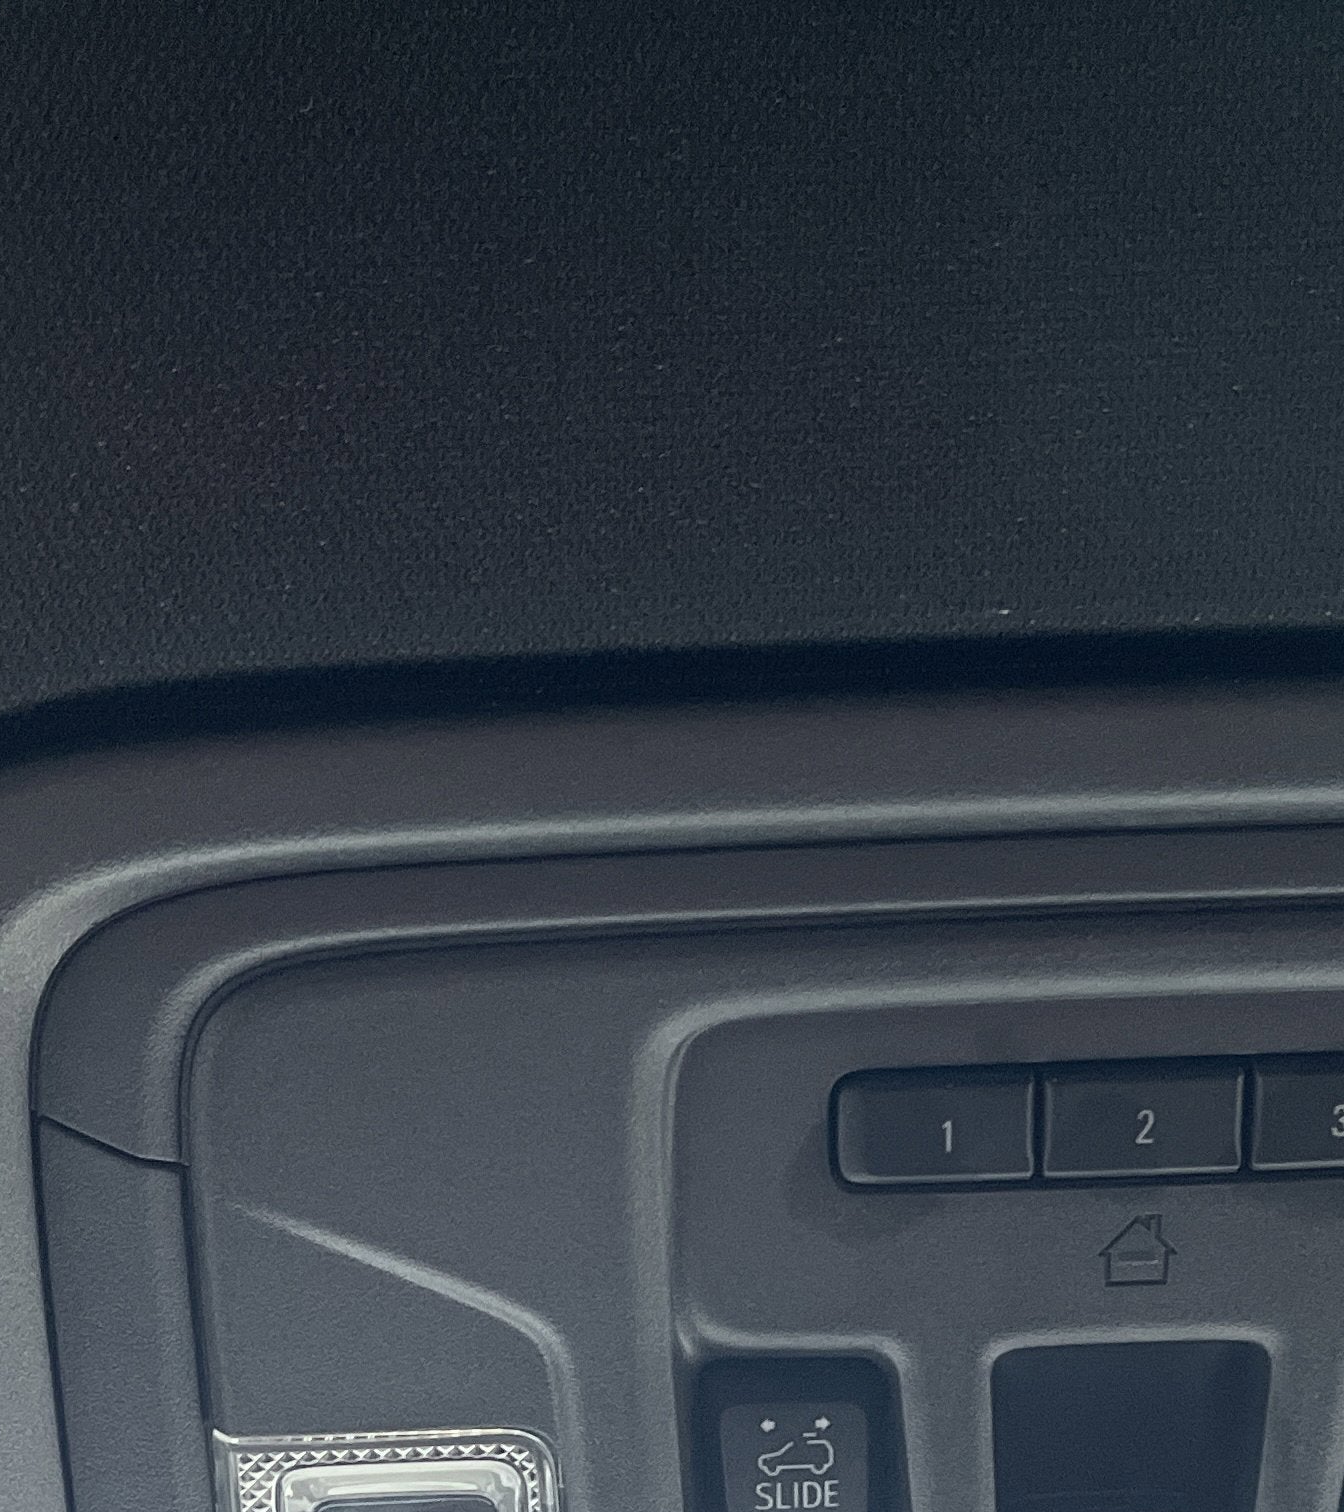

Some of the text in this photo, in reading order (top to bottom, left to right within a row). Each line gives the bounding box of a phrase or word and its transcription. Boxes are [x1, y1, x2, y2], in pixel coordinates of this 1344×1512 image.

[940, 1120, 954, 1152] 1
[1135, 1109, 1156, 1145] 2
[754, 1480, 841, 1512] SLIDE
